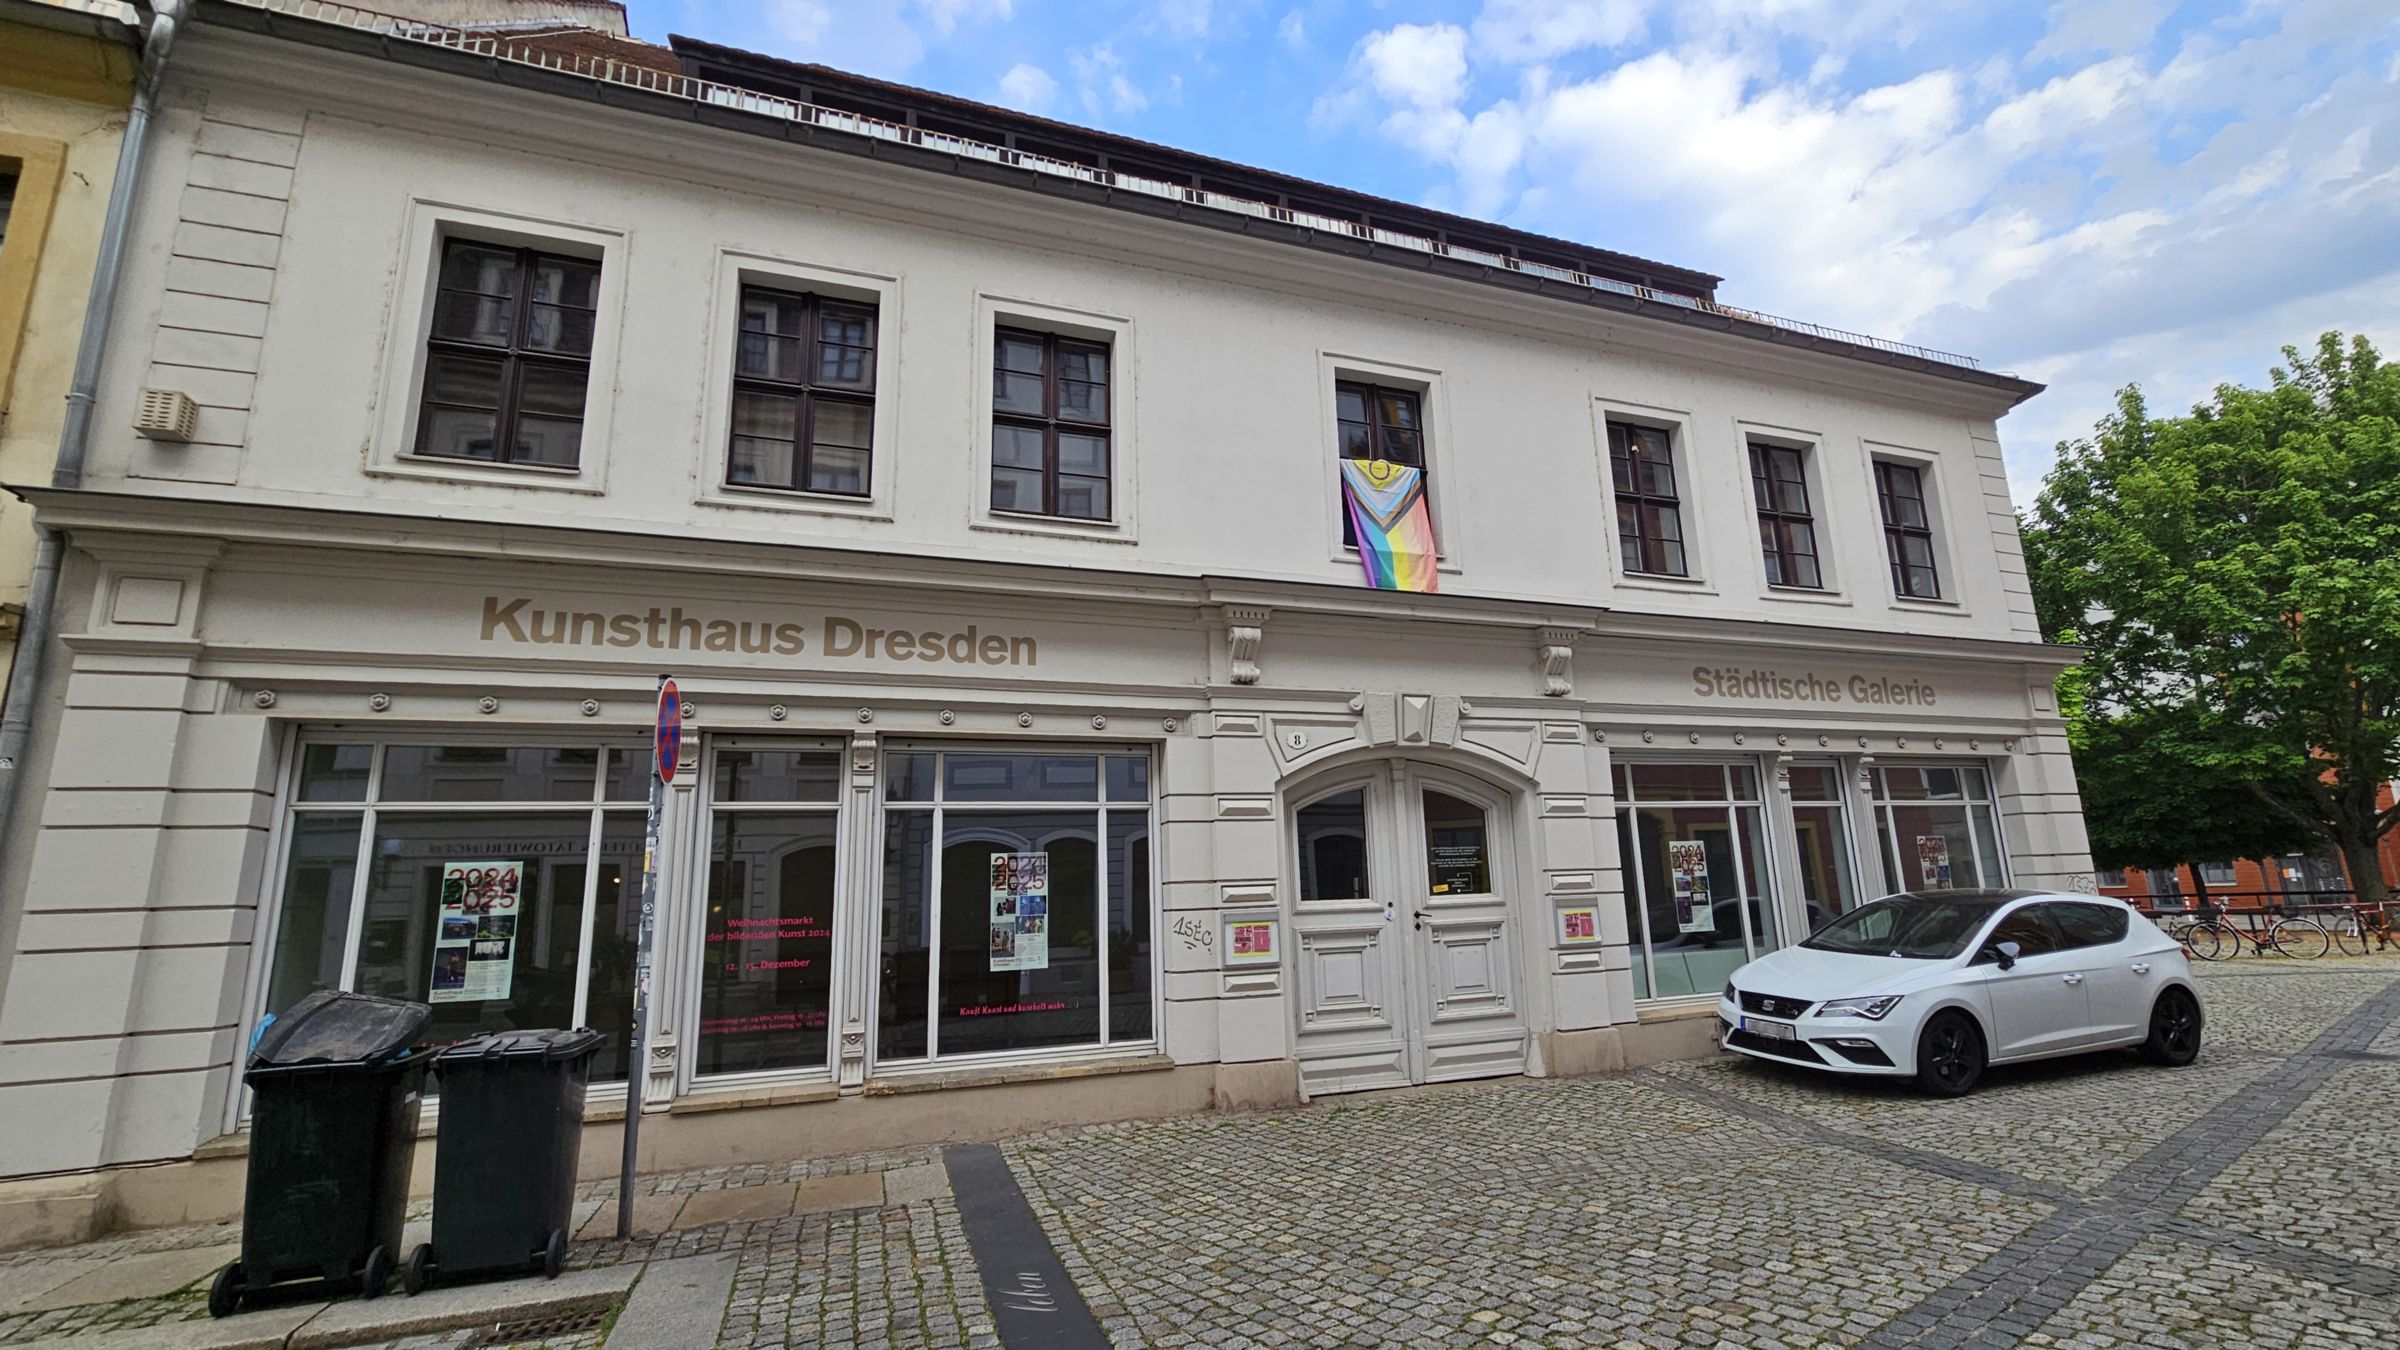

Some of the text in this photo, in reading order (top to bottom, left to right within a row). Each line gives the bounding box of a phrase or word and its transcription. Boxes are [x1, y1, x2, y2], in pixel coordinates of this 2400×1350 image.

[480, 596, 1037, 666] Kunsthaus Dresden
[1692, 666, 1937, 706] Städtische Galerie
[1294, 734, 1301, 746] 8
[994, 856, 1046, 874] 2024
[994, 872, 1045, 891] 2025
[728, 916, 813, 928] Weihnachtsmarkt
[707, 932, 725, 942] der
[727, 930, 776, 940] bildenden
[778, 929, 806, 938] Kunst
[761, 958, 811, 969] Dezember
[982, 1005, 1002, 1014] Kunst
[1004, 1004, 1017, 1013] und
